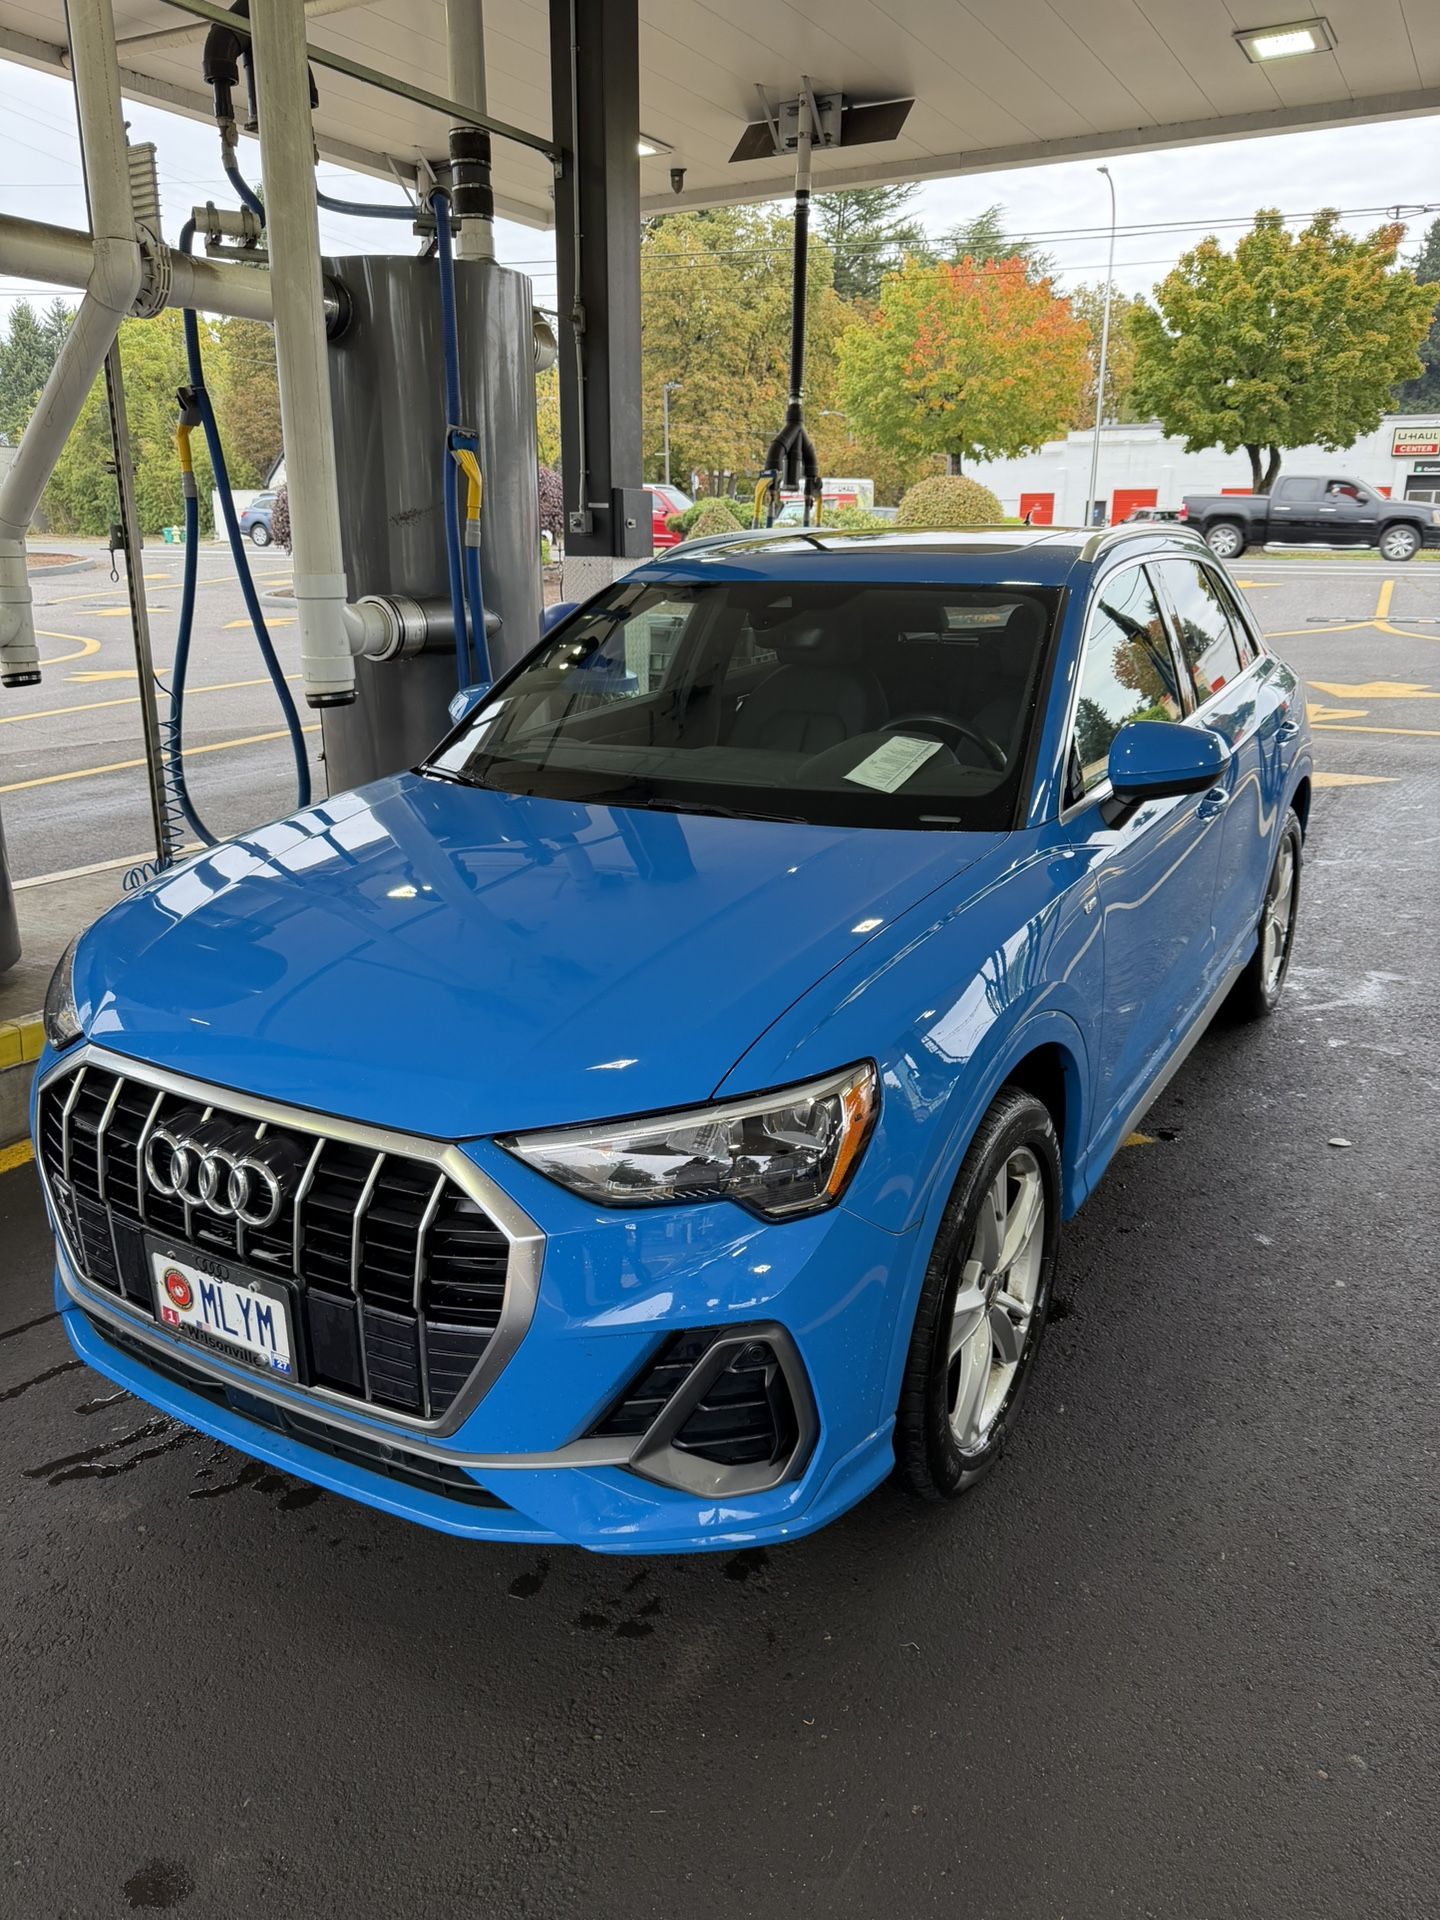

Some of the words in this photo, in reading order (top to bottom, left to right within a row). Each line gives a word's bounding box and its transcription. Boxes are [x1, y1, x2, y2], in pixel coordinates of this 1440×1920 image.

[1398, 432, 1438, 440] U-HAUL
[167, 1311, 176, 1323] 1
[199, 1278, 277, 1351] MLYM
[276, 1359, 288, 1370] 27
